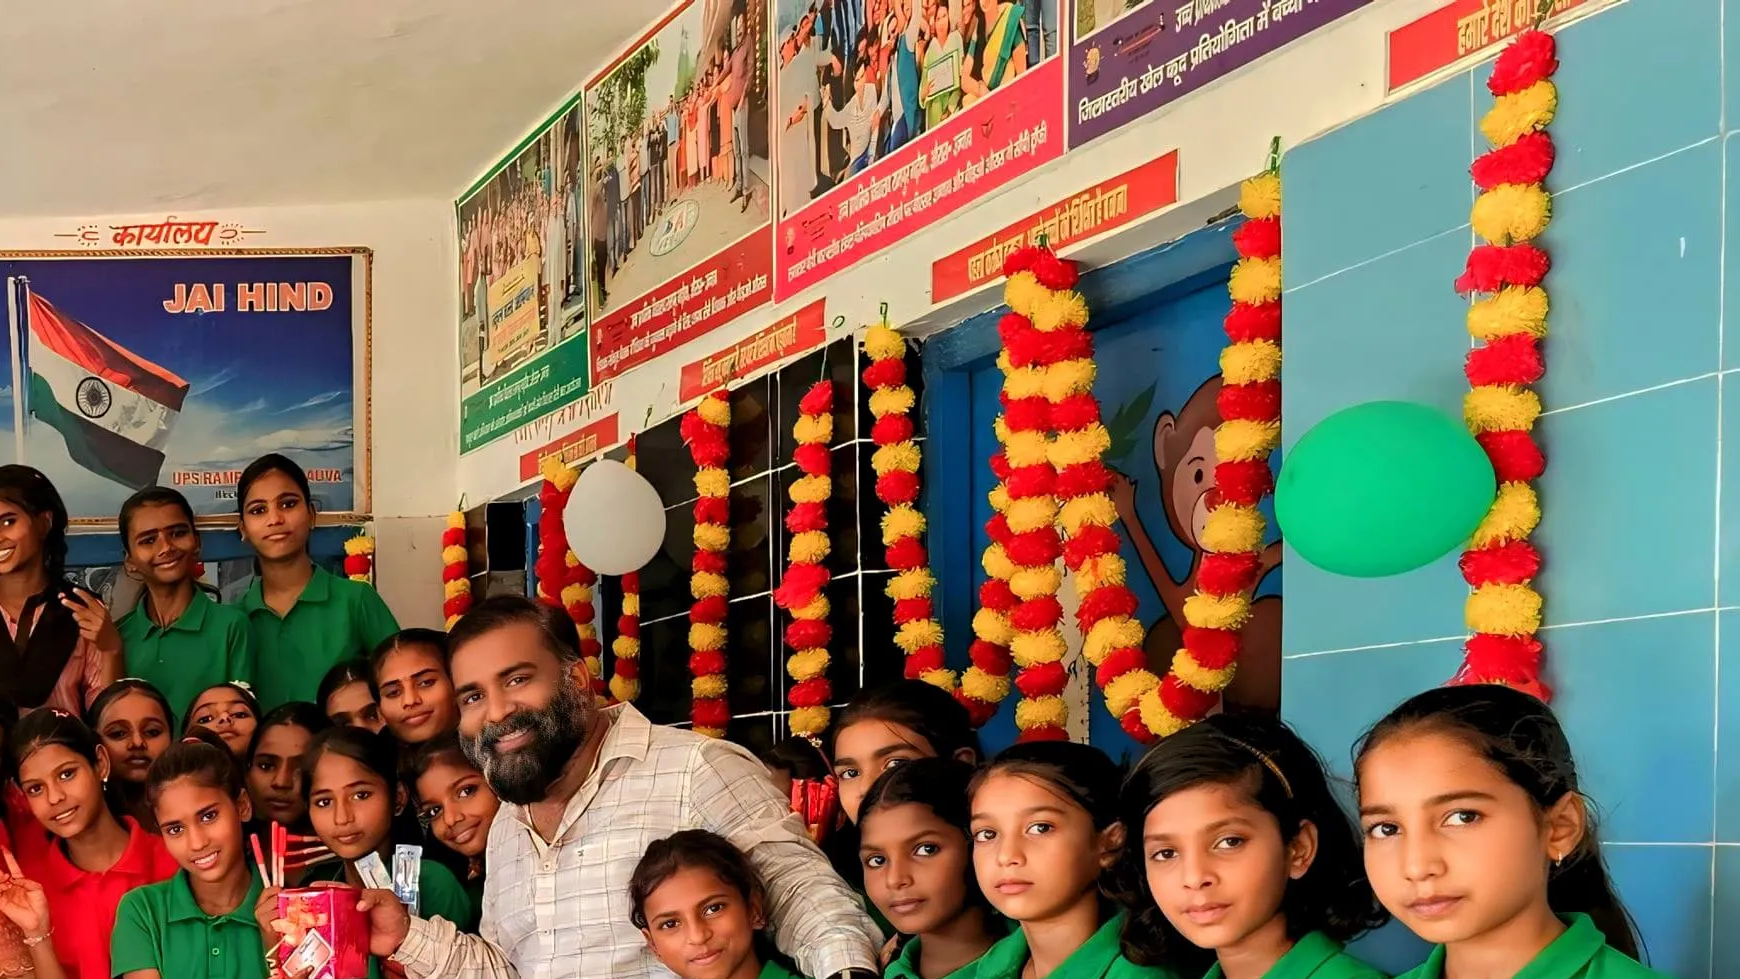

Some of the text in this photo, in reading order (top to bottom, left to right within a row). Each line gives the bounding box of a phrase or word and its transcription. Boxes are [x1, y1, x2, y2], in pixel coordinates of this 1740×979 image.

[1078, 76, 1138, 125] जिलास्तरीय
[1140, 64, 1164, 94] खेल
[1166, 52, 1188, 87] कूद
[1190, 18, 1255, 71] प्रतियोगिता
[109, 215, 219, 246] कार्यालय
[162, 281, 334, 314] JAI HIND
